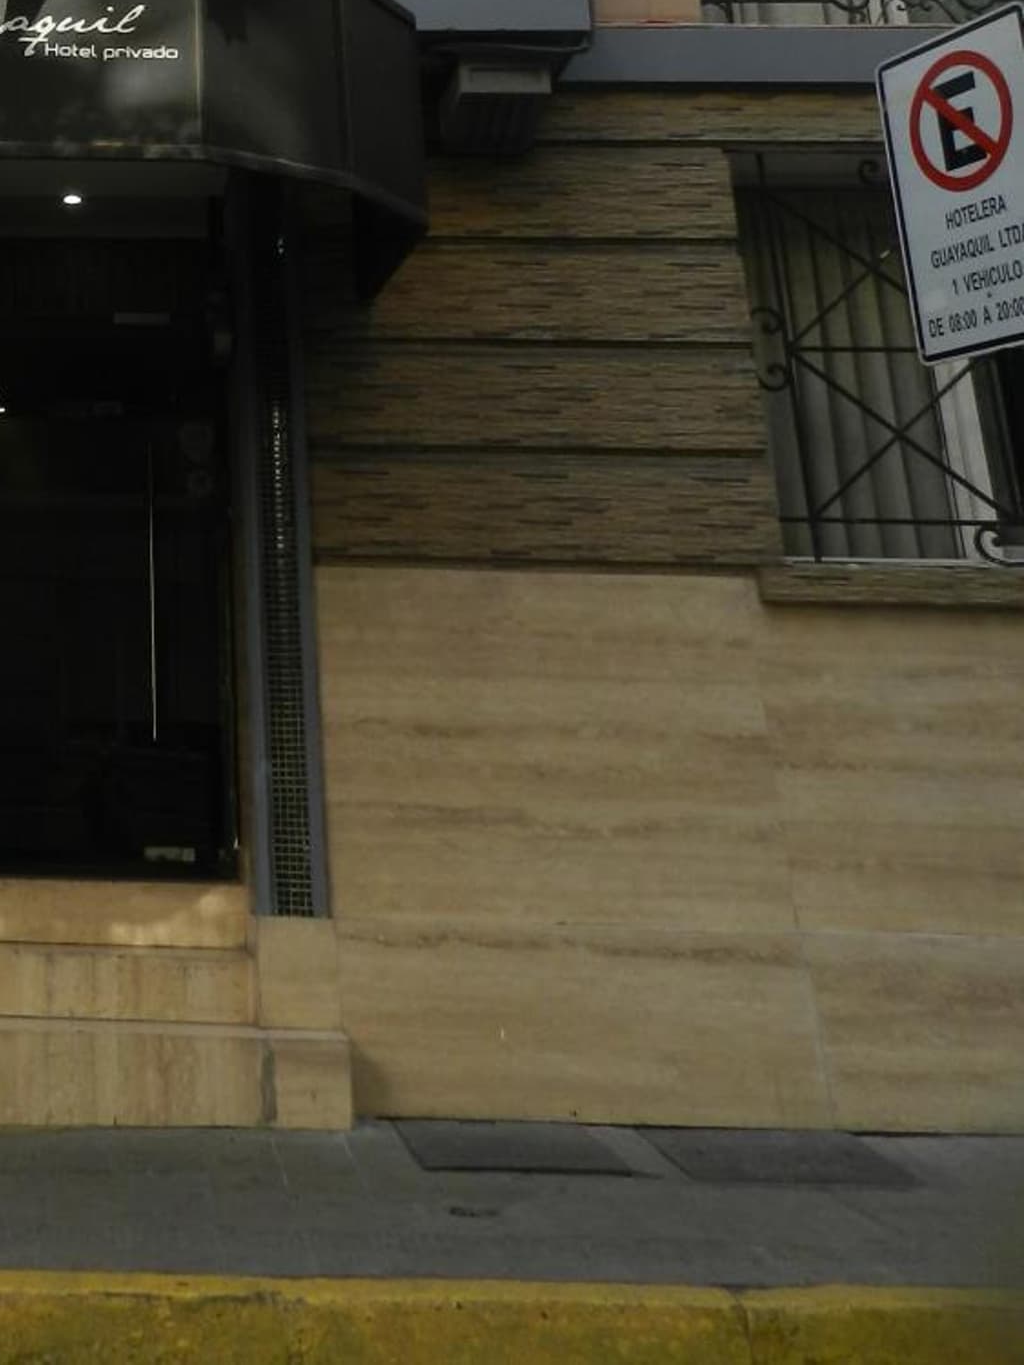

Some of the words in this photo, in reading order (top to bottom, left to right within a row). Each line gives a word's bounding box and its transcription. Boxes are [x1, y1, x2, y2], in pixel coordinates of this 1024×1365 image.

[45, 42, 97, 59] Hotel
[103, 45, 179, 61] privado
[945, 195, 1007, 230] HOTELERA
[930, 234, 995, 269] GUAYAQUIL
[998, 222, 1024, 248] LTD
[952, 278, 959, 295] 1
[963, 260, 1023, 293] VEHICULO
[928, 317, 945, 338] DE
[948, 308, 977, 334] 08:00
[983, 305, 992, 325] A
